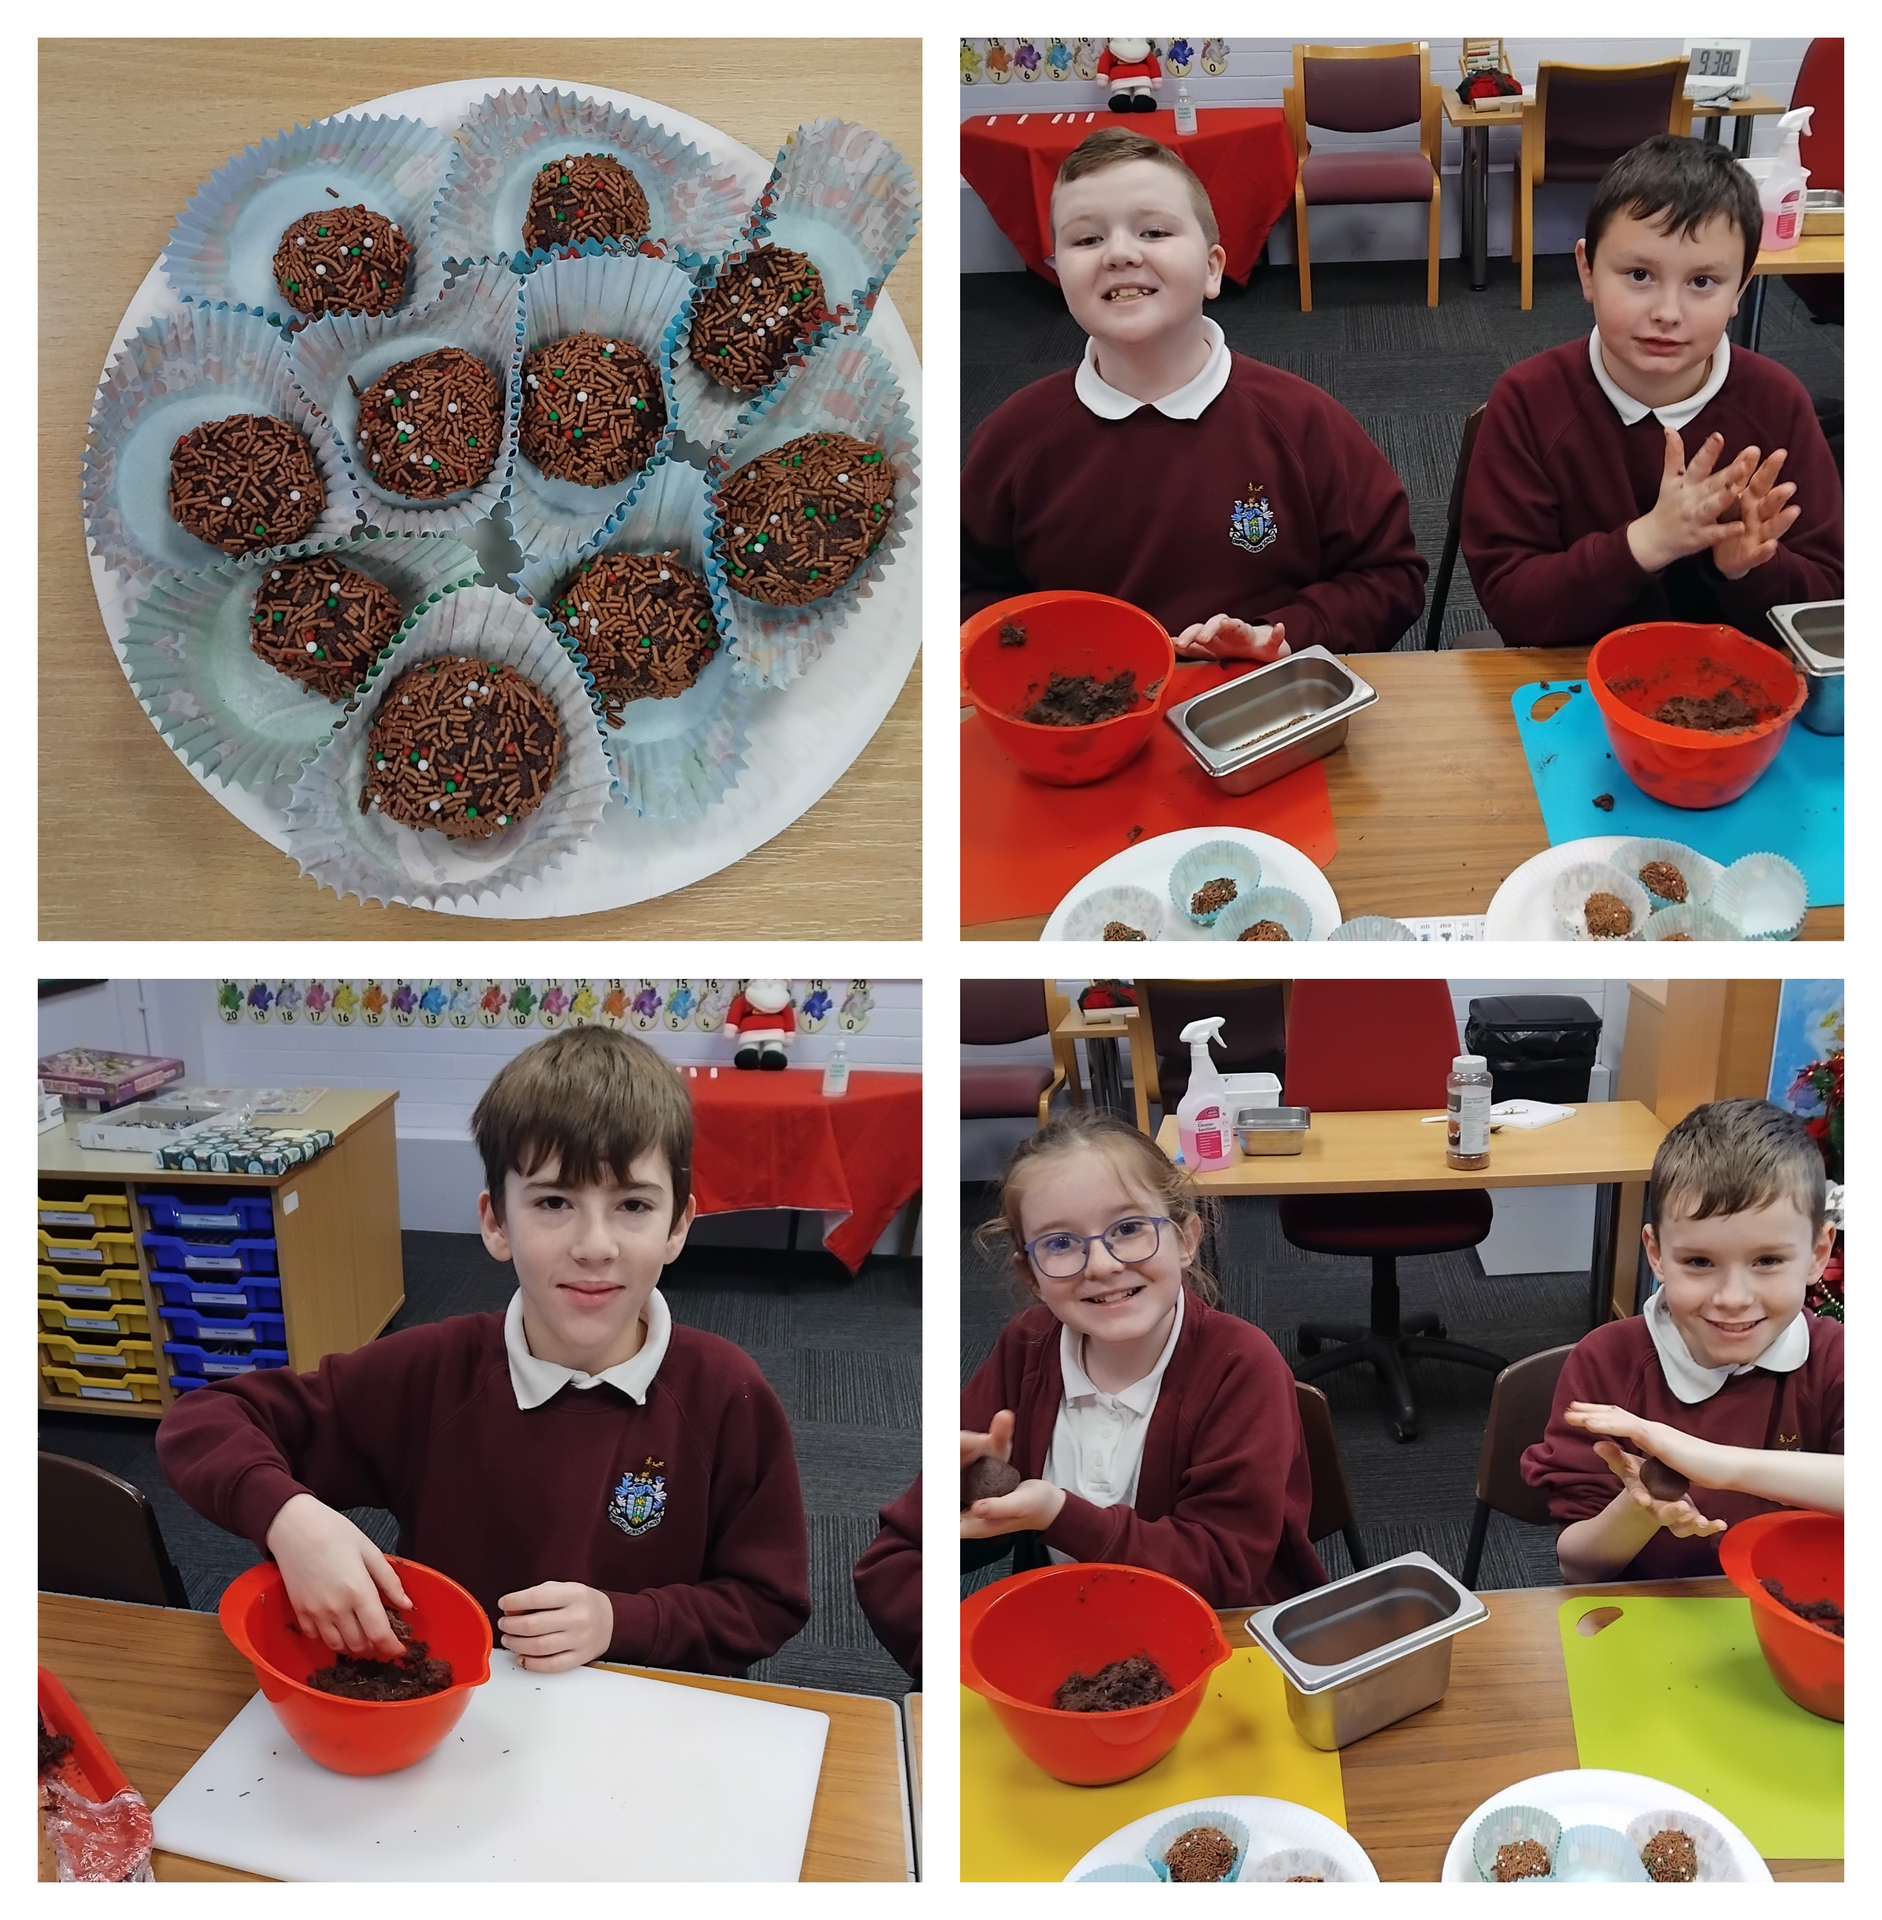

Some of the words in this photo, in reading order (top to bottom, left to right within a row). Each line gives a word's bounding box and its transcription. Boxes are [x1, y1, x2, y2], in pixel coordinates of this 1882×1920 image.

[988, 38, 999, 46] 13
[1016, 37, 1028, 45] 14
[965, 73, 972, 82] 8
[995, 72, 1001, 81] 7
[1024, 70, 1030, 79] 6
[1053, 69, 1060, 78] 5
[1082, 68, 1088, 77] 4
[1175, 65, 1180, 74] 1
[1209, 63, 1216, 72] 0
[1698, 50, 1733, 76] 9:38
[575, 979, 586, 988] 12
[609, 979, 620, 988] 13
[640, 979, 650, 988] 14
[676, 979, 688, 989] 15
[705, 979, 717, 989] 16
[811, 979, 823, 990] 19
[852, 979, 866, 990] 20
[225, 1011, 238, 1021] 20
[254, 1011, 265, 1021] 19
[282, 1011, 293, 1021] 18
[311, 1012, 321, 1021] 17
[338, 1013, 349, 1023] 16
[367, 1014, 378, 1023] 15
[397, 1014, 408, 1024] 14
[425, 1015, 437, 1024] 13
[455, 1015, 467, 1025] 12
[484, 1015, 495, 1024] 11
[514, 1015, 526, 1025] 10
[546, 1016, 553, 1025] 9
[577, 1017, 584, 1026] 8
[609, 1018, 615, 1027] 7
[639, 1018, 646, 1027] 6
[671, 1018, 678, 1028] 5
[703, 1018, 710, 1028] 4
[808, 1020, 812, 1029] 1
[847, 1019, 854, 1030] 0
